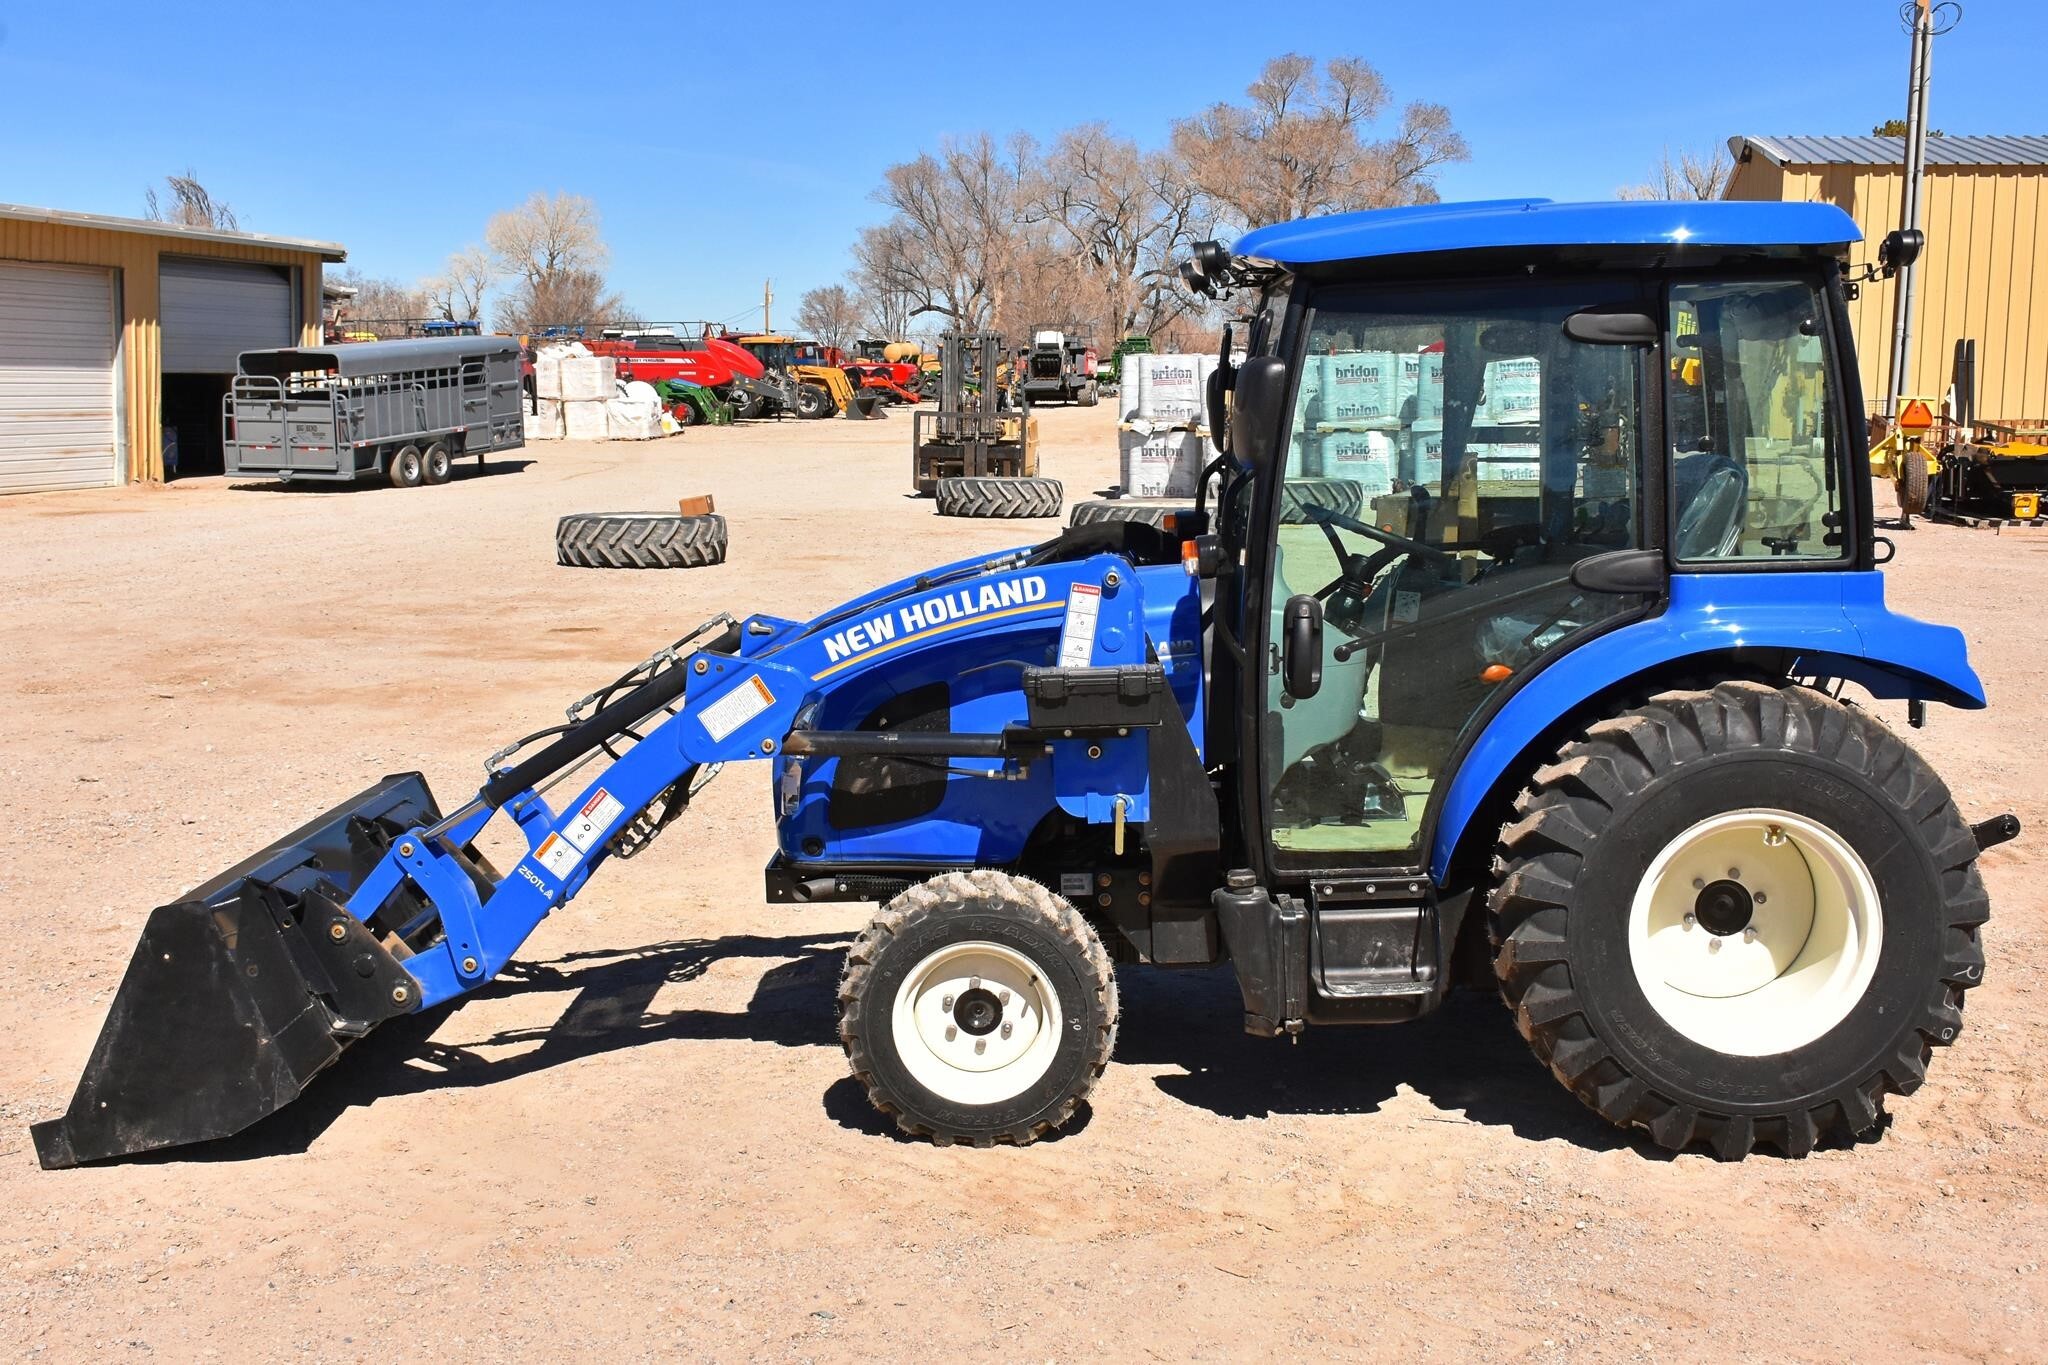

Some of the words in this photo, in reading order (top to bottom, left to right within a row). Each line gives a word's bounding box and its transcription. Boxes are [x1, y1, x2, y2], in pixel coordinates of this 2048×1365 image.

[1151, 366, 1192, 380] bridon
[1335, 364, 1379, 378] bridon
[1141, 443, 1184, 457] bridon
[822, 613, 896, 663] NEW
[901, 575, 1047, 633] HOLLAND
